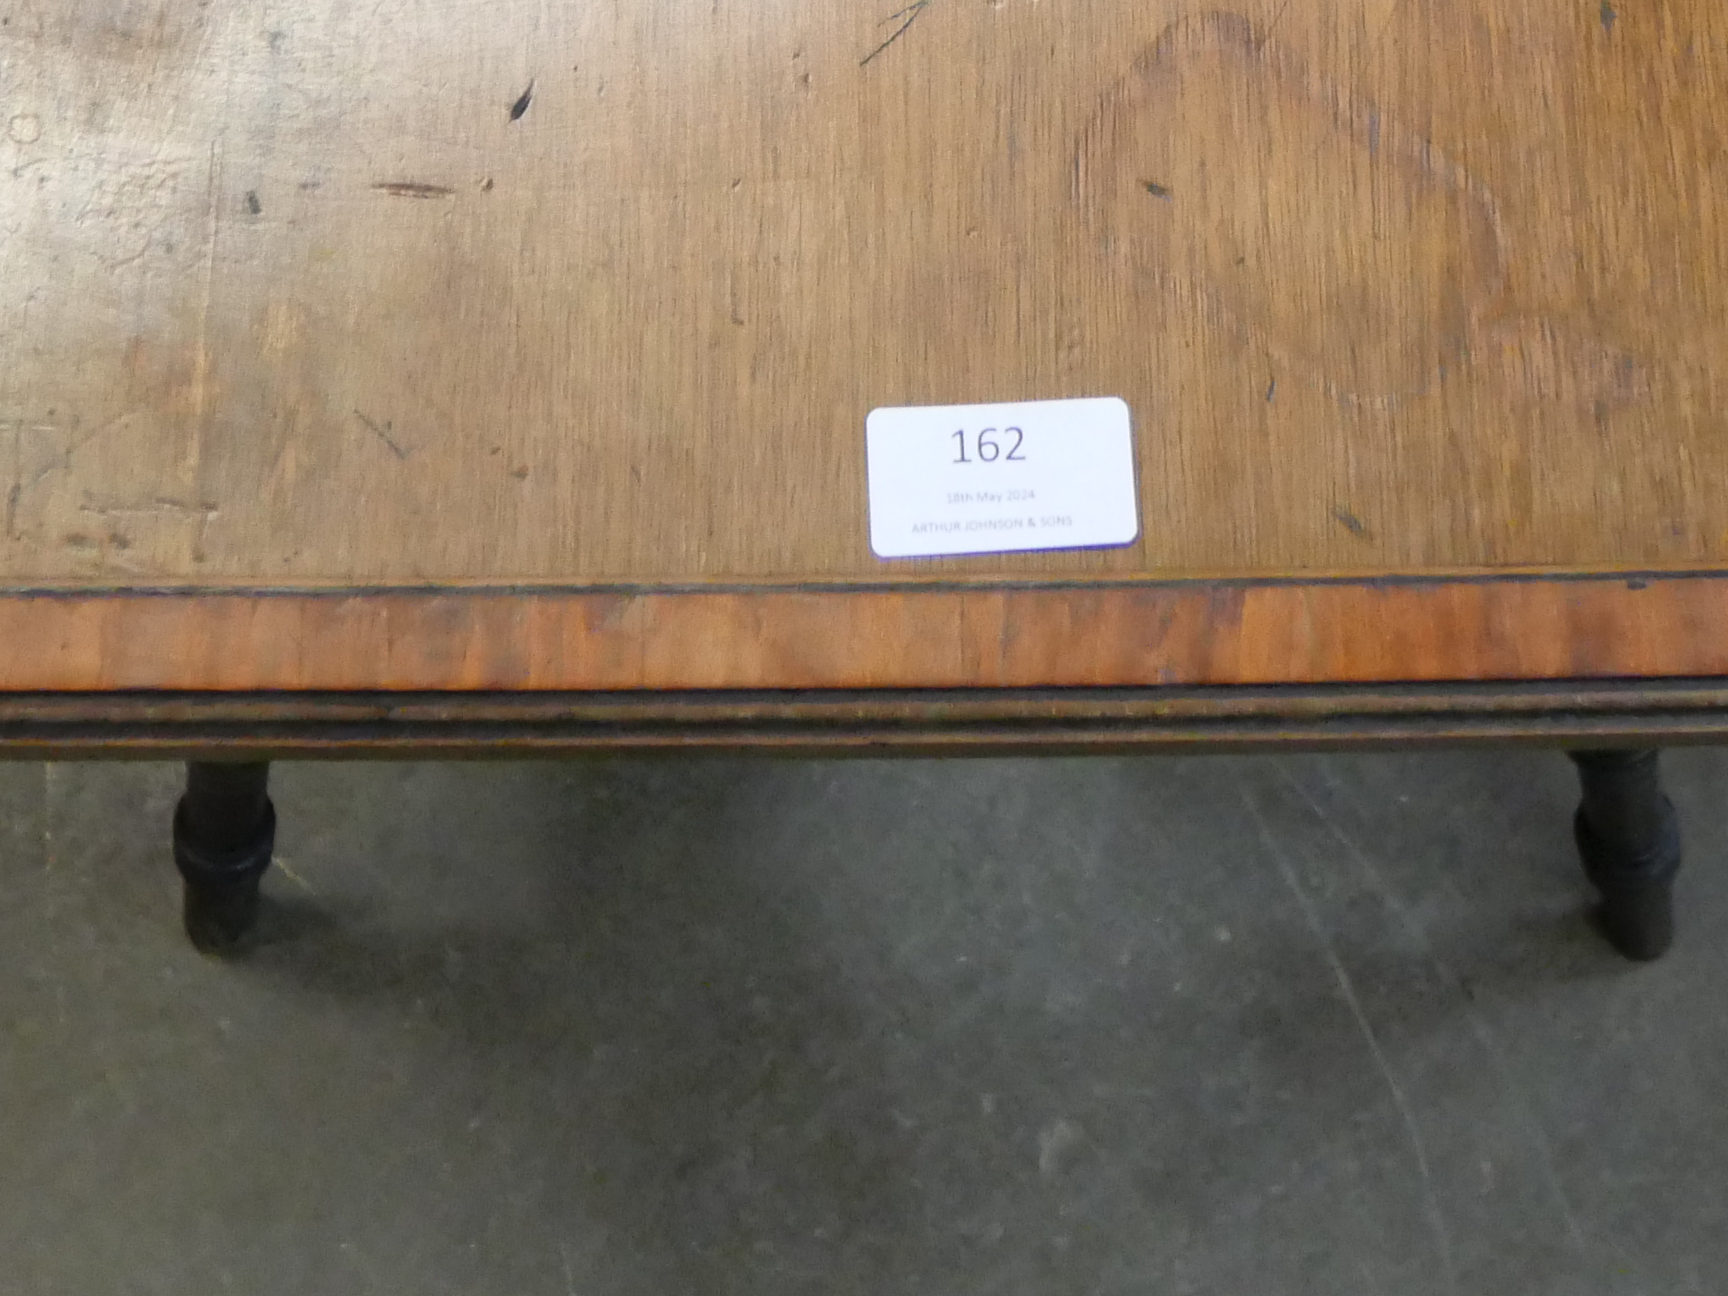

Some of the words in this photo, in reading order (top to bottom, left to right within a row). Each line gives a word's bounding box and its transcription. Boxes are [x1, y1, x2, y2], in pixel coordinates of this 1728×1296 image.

[951, 426, 1027, 464] 162
[976, 490, 1003, 504] May
[911, 520, 961, 534] ARTHUR
[965, 517, 1023, 532] JOHNSON
[1027, 517, 1036, 528] &
[1040, 514, 1073, 528] SONS
